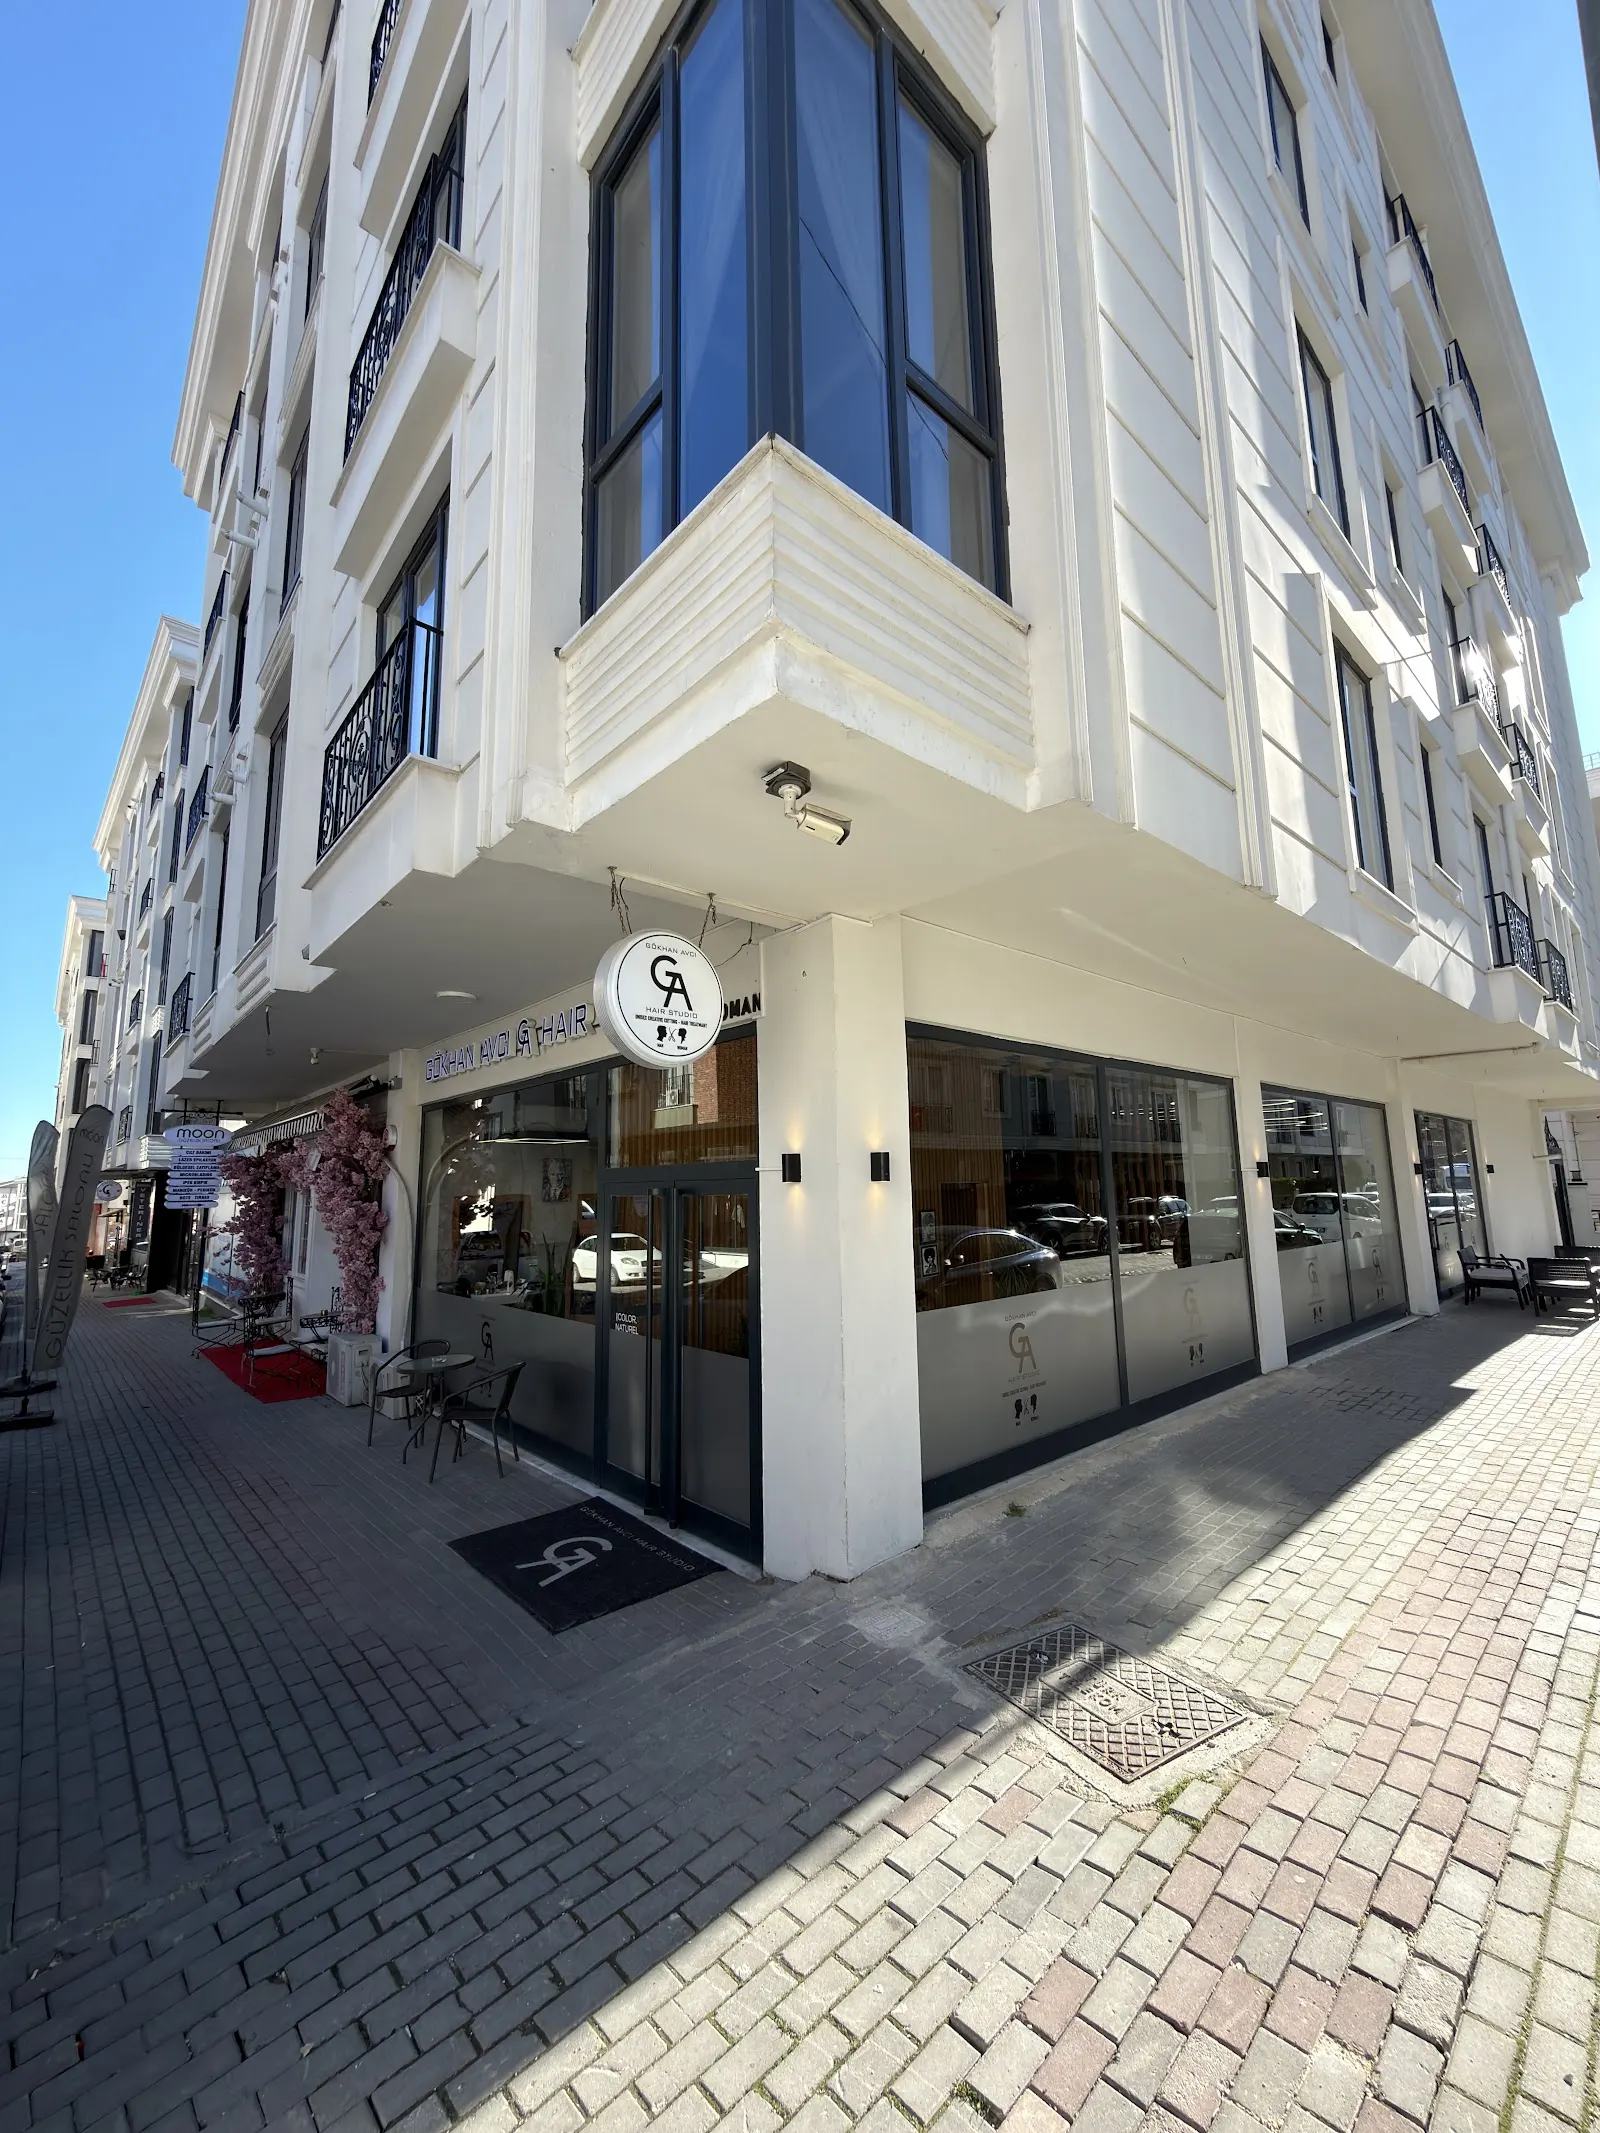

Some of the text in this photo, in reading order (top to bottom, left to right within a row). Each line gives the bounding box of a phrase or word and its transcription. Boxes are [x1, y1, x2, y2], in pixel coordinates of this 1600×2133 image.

[646, 942, 697, 958] GÖKHAN AVCI
[645, 1006, 698, 1019] HAIR STUDIO
[425, 1042, 475, 1082] GÖKHAN
[480, 1030, 510, 1064] AVCI
[541, 1003, 588, 1046] HAIR
[176, 1128, 225, 1139] moon
